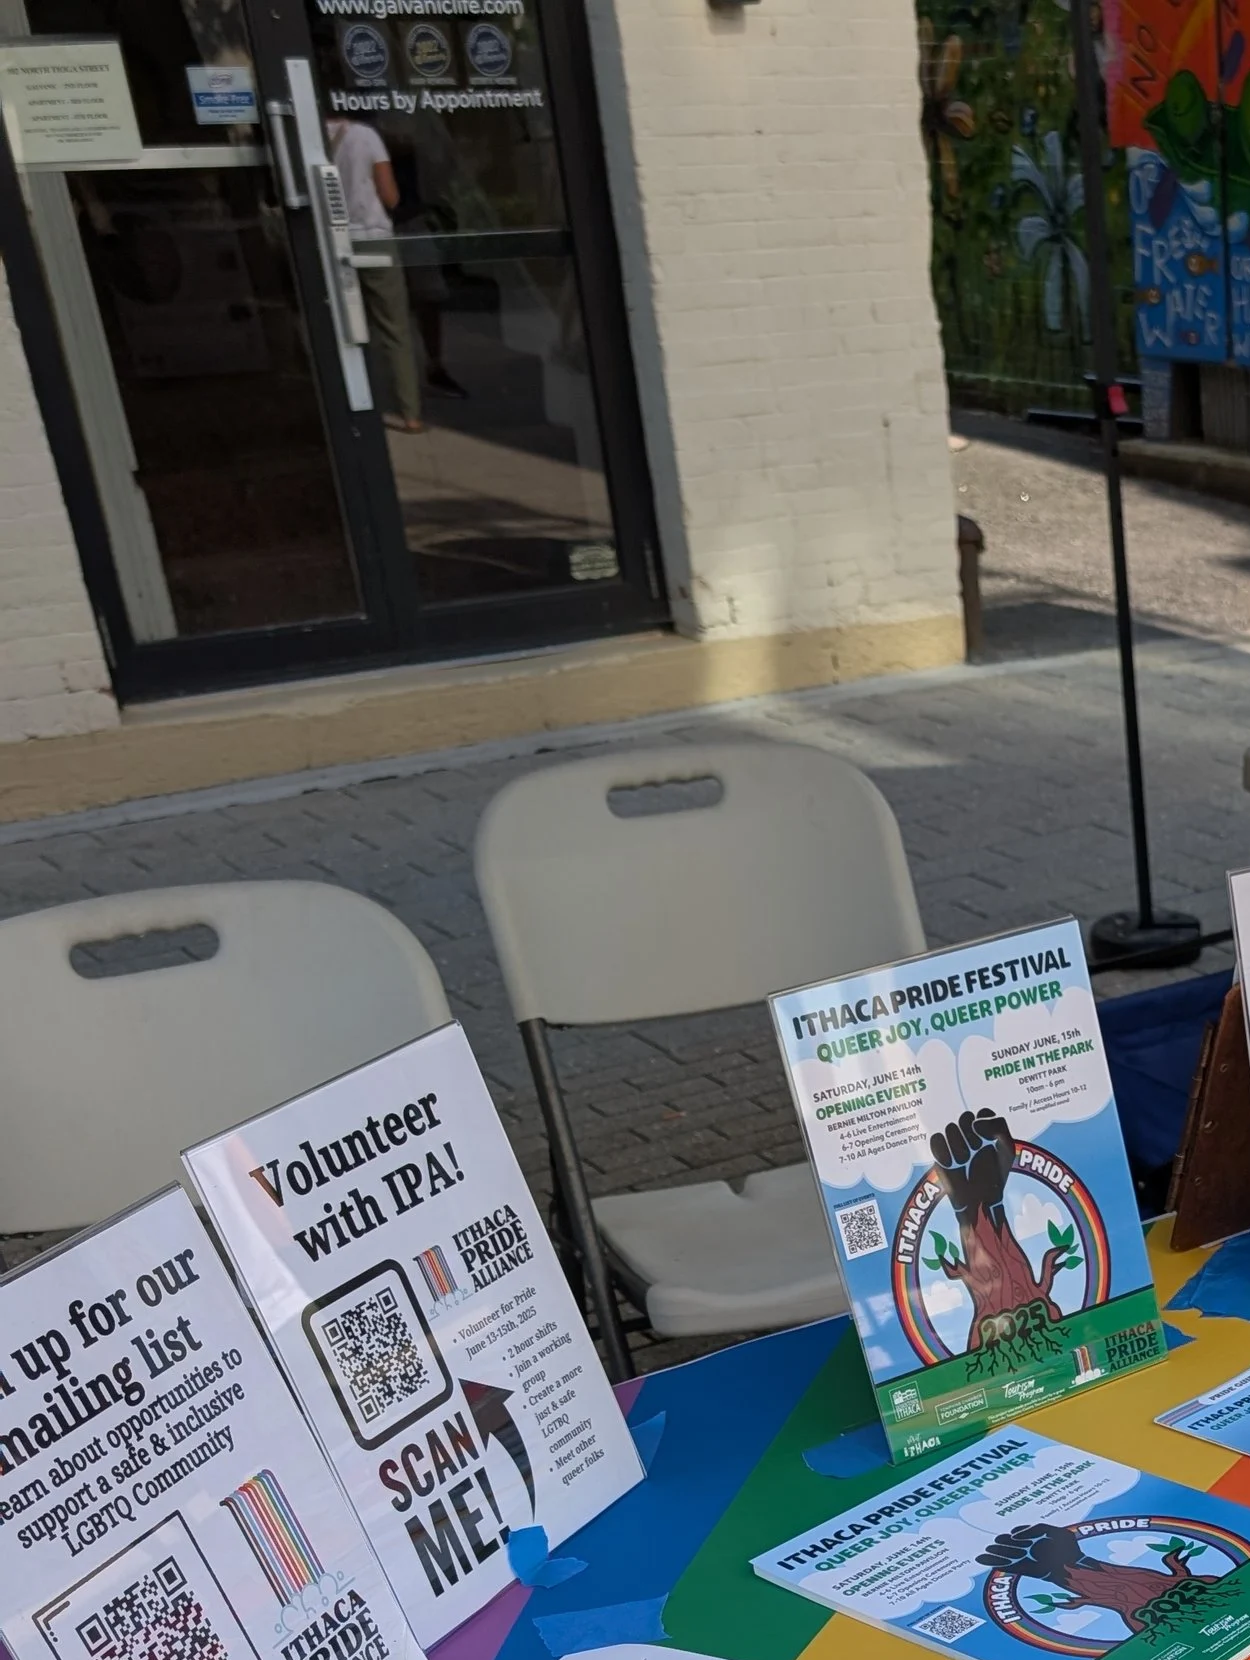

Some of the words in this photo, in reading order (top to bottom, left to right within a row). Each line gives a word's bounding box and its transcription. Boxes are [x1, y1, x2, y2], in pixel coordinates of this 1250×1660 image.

[330, 91, 390, 111] Hours
[392, 90, 417, 114] by
[421, 88, 544, 113] Appointment
[792, 995, 889, 1039] ITHACA
[891, 974, 963, 1013] PRIDE
[964, 947, 1071, 993] FESTIVAL
[816, 1029, 883, 1063] QUEER
[885, 1017, 929, 1044] JOY,
[930, 999, 993, 1031] QUEER
[994, 980, 1062, 1013] POWER
[984, 1060, 1021, 1080] PRIDE
[1022, 1055, 1037, 1069] IN
[1036, 1048, 1061, 1065] THE
[1061, 1039, 1094, 1058] PARK
[991, 1041, 1030, 1061] SUNDAY
[1033, 1034, 1060, 1049] JUNE,
[1061, 1028, 1081, 1040] 15th
[1018, 1070, 1046, 1084] DEWITT
[1047, 1064, 1067, 1076] PARK
[813, 1078, 870, 1103] SATURDAY,
[872, 1070, 899, 1086] JUNE
[899, 1063, 921, 1077] 14th
[815, 1093, 876, 1120] OPENING
[875, 1078, 926, 1103] EVENTS
[248, 1092, 441, 1207] Volunteer
[1018, 1151, 1075, 1195] PRIDE
[292, 1188, 388, 1262] with
[381, 1141, 464, 1215] IPA!
[897, 1179, 941, 1266] ITHACA
[9, 1329, 71, 1381] up
[69, 1288, 133, 1348] for
[136, 1248, 200, 1307] our
[457, 1309, 500, 1339] Volunteer
[500, 1300, 514, 1314] for
[513, 1287, 536, 1306] Pride
[465, 1340, 486, 1360] June
[485, 1319, 519, 1344] 13-15th,
[517, 1305, 537, 1324] 2025
[981, 1304, 1045, 1342] 2025
[131, 1315, 202, 1379] list
[17, 1482, 98, 1549] support
[96, 1475, 113, 1494] a
[111, 1445, 151, 1484] safe
[149, 1433, 171, 1456] &
[165, 1382, 244, 1445] inclusive
[60, 1495, 137, 1557] LGBTQ
[132, 1425, 234, 1506] Community
[378, 1413, 475, 1512] SCAN
[404, 1466, 517, 1597] ME!
